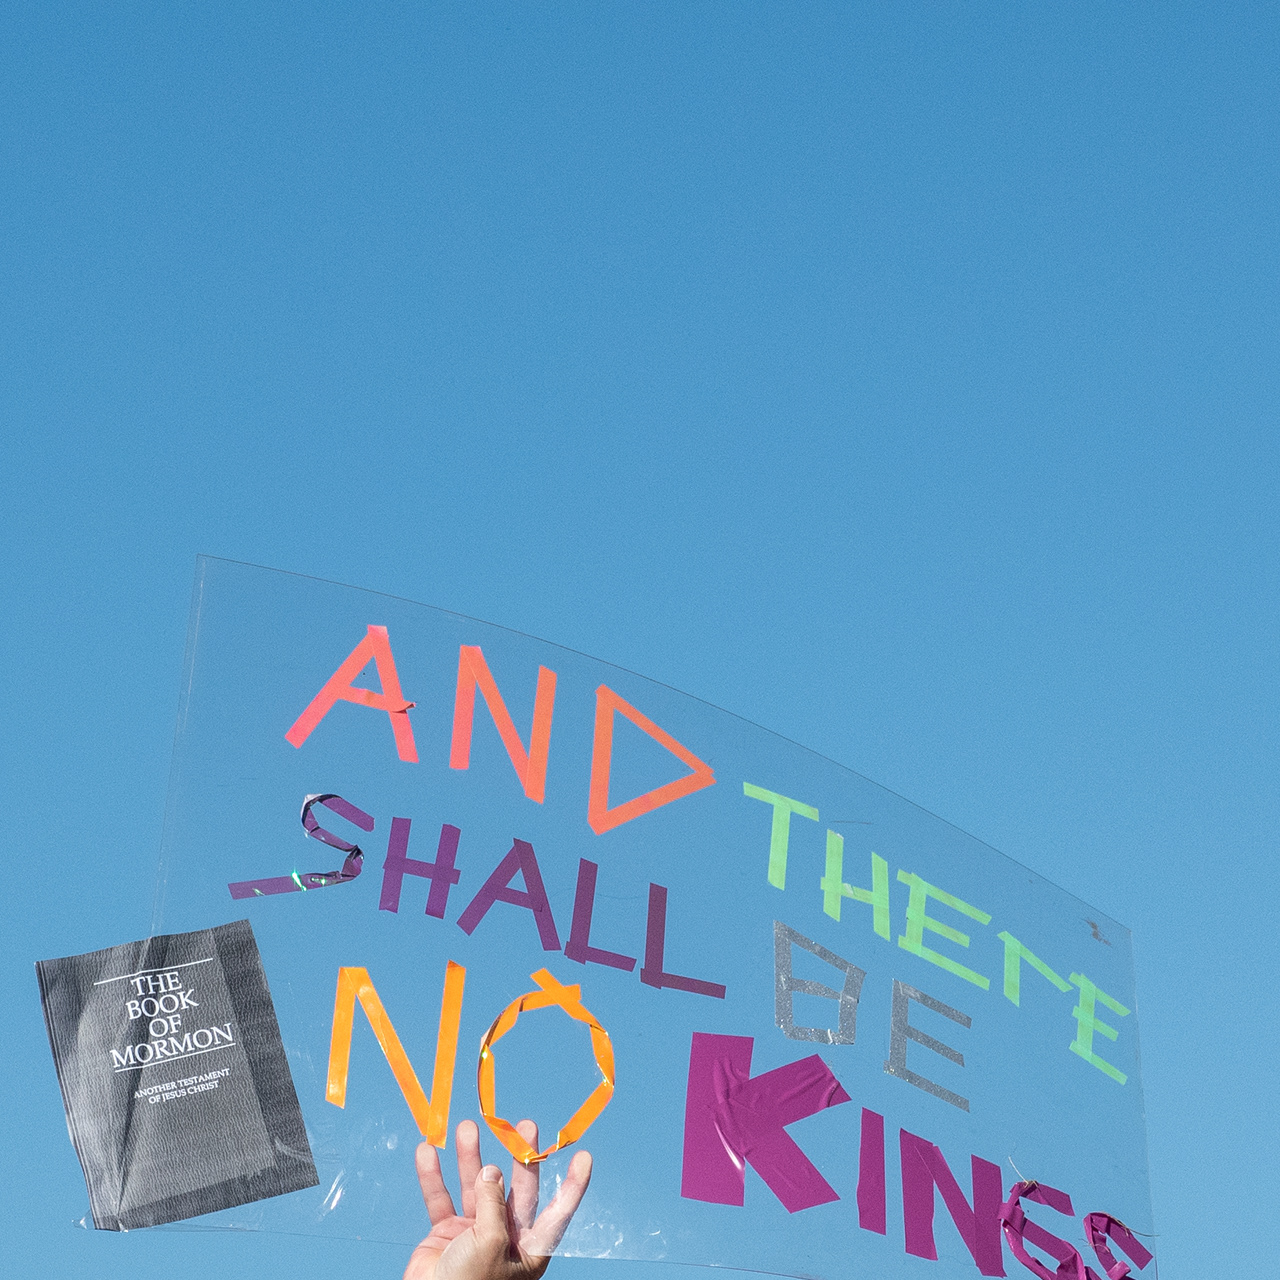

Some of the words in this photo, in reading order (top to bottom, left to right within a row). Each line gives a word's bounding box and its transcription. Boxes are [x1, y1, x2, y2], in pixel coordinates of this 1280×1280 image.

[285, 624, 716, 835] AND
[226, 793, 726, 999] SHALL
[773, 919, 973, 1114] BE
[131, 970, 183, 997] THE
[125, 988, 200, 1020] BOOK
[148, 1013, 183, 1038] OF
[109, 1022, 234, 1069] MORMON
[325, 959, 616, 1164] NO
[134, 1081, 177, 1098] ANOTHER
[178, 1069, 230, 1087] TESTAMENT
[148, 1093, 162, 1105] OF
[161, 1088, 187, 1102] JESUS
[187, 1081, 219, 1096] CHRIST
